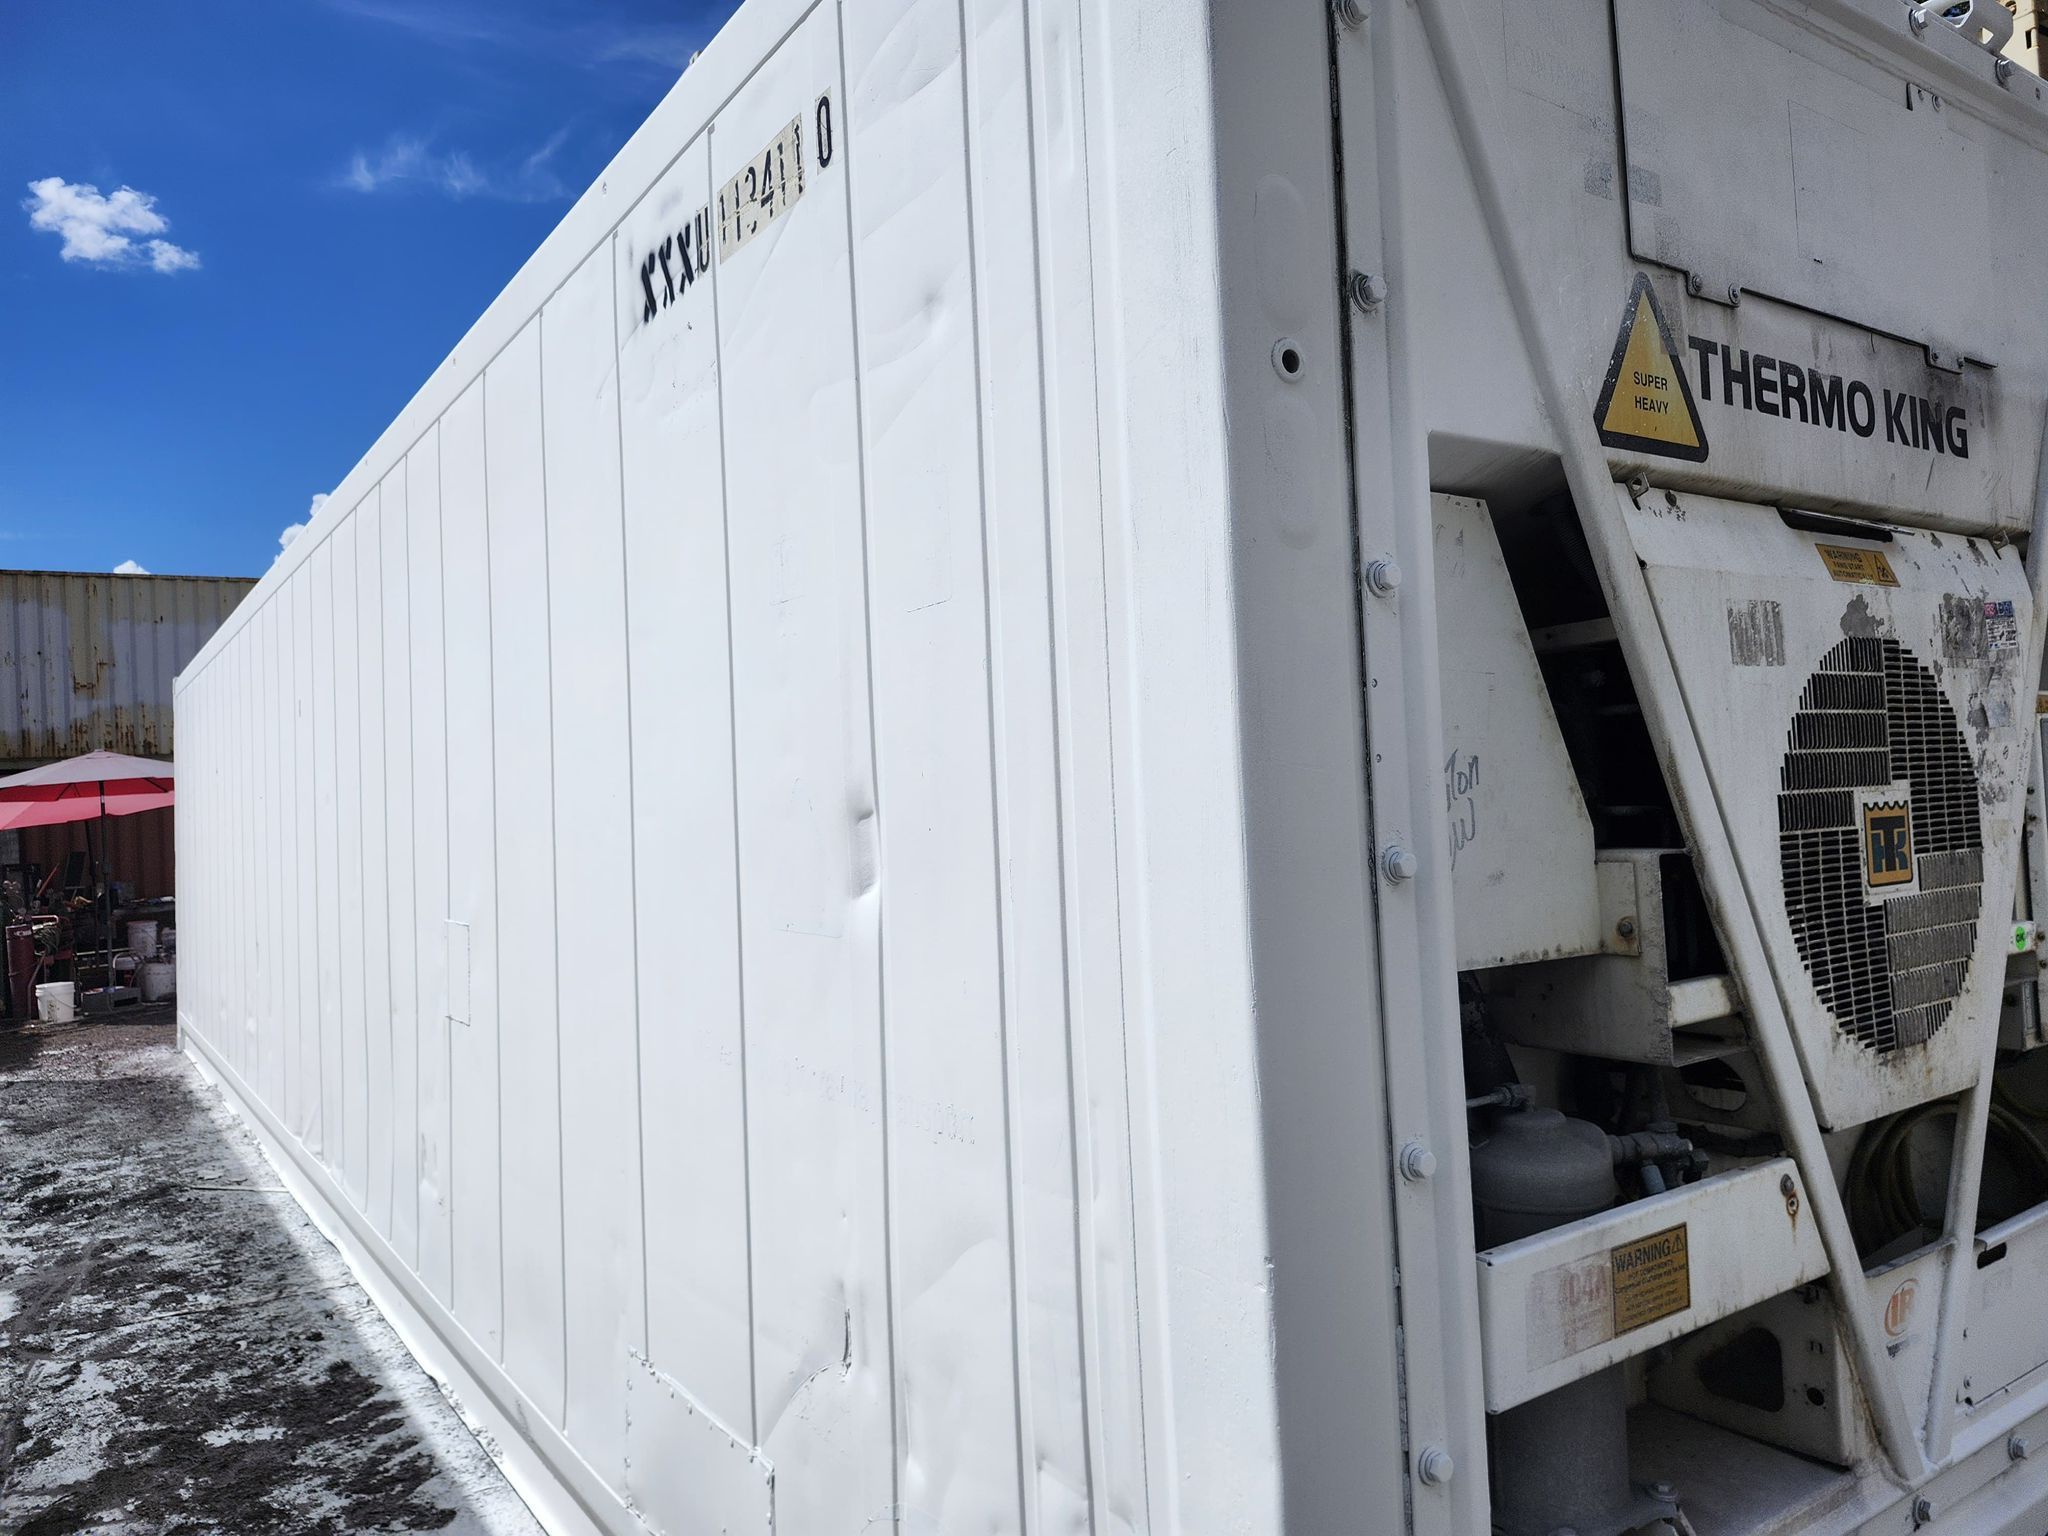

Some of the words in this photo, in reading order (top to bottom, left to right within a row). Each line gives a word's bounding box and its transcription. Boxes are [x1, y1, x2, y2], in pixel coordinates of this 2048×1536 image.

[816, 96, 832, 168] 0
[1633, 371, 1668, 391] SUPER
[1688, 335, 1876, 438] THERMO
[1883, 388, 1970, 459] KING
[1634, 395, 1669, 415] HEAVY
[1614, 1238, 1671, 1273] WARNING
